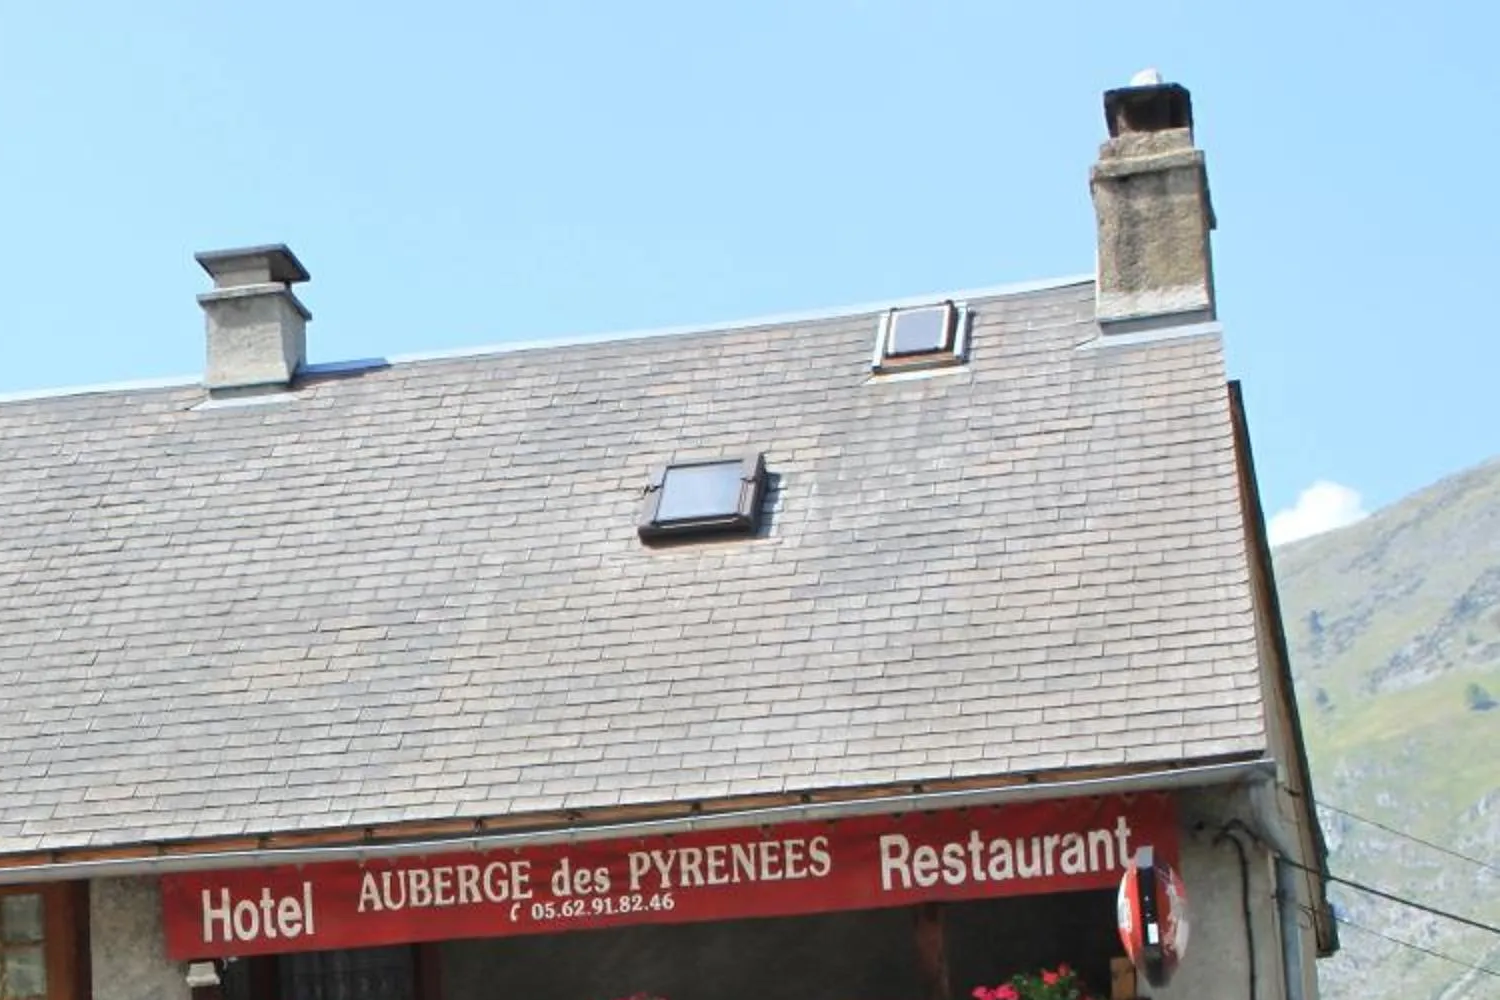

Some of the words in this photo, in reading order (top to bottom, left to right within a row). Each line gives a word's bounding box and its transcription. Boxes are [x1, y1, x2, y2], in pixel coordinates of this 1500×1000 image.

[357, 860, 533, 912] AUBERGE
[551, 857, 611, 897] des
[628, 836, 832, 891] PYRENEES
[879, 815, 1136, 891] Restaurant
[202, 880, 315, 943] Hotel
[531, 891, 676, 921] 05.62.91.82.46
